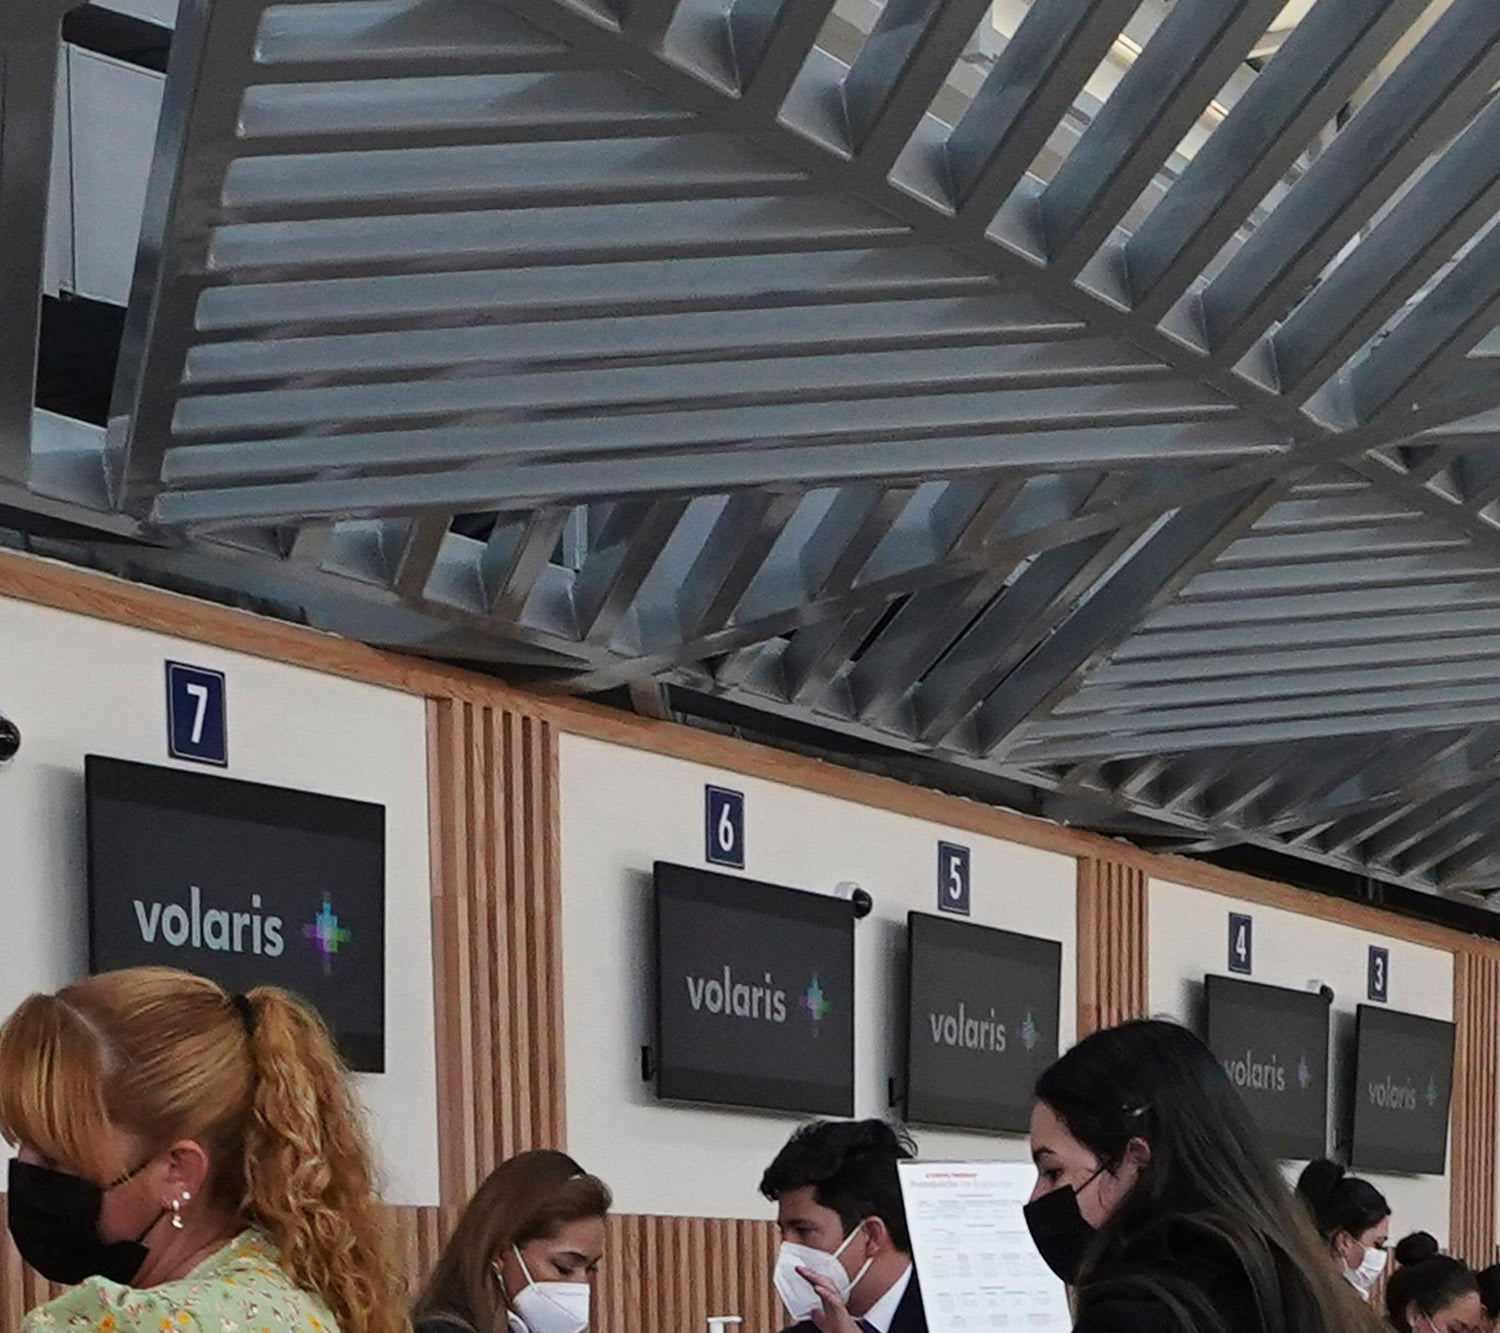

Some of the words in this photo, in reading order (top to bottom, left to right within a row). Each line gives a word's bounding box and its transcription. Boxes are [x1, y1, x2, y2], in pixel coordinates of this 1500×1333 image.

[186, 683, 209, 744] 7
[718, 803, 735, 852] 6
[948, 856, 963, 901] 5
[133, 886, 285, 958] volaris
[1235, 924, 1248, 963] 4
[686, 965, 787, 1023] volaris
[1374, 956, 1384, 993] 3
[930, 1002, 1006, 1053] volaris
[1367, 1076, 1417, 1111] volaris
